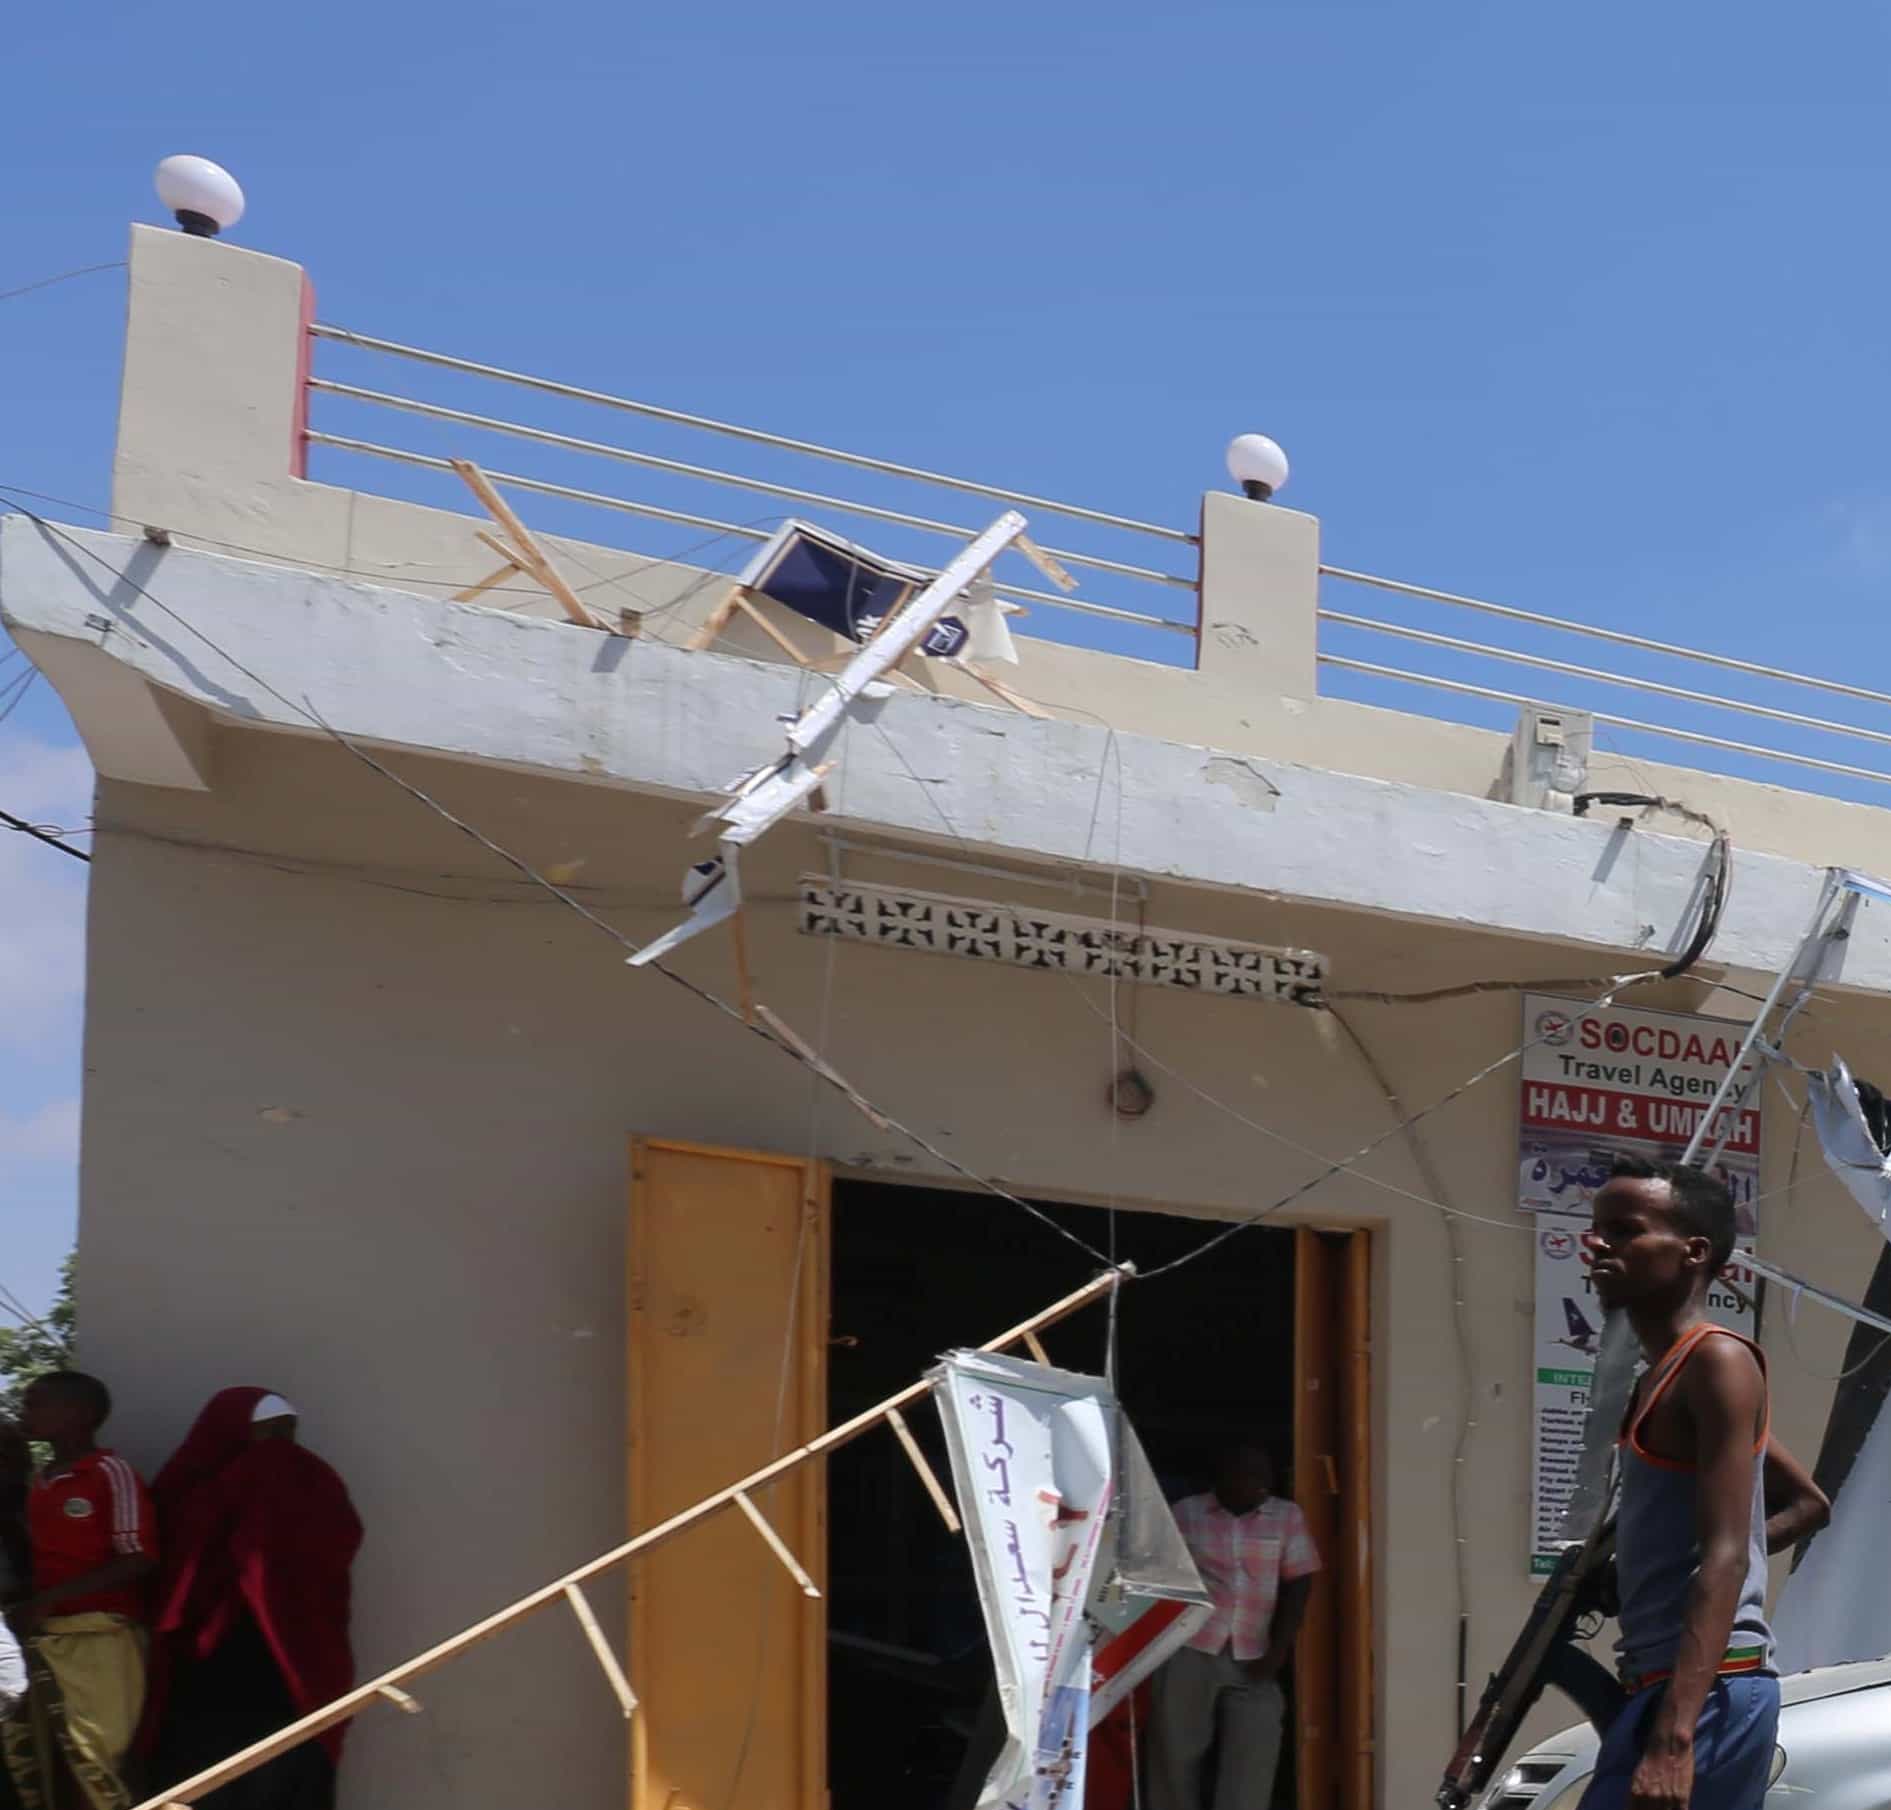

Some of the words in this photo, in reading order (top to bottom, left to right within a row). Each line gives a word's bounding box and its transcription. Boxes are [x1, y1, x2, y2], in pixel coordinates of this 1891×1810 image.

[1580, 1018, 1752, 1071] SOCDAAL
[1559, 1054, 1640, 1086] Travel
[1648, 1067, 1747, 1104] Ageny
[1529, 1087, 1606, 1125] HAJJ
[1617, 1099, 1637, 1129] &
